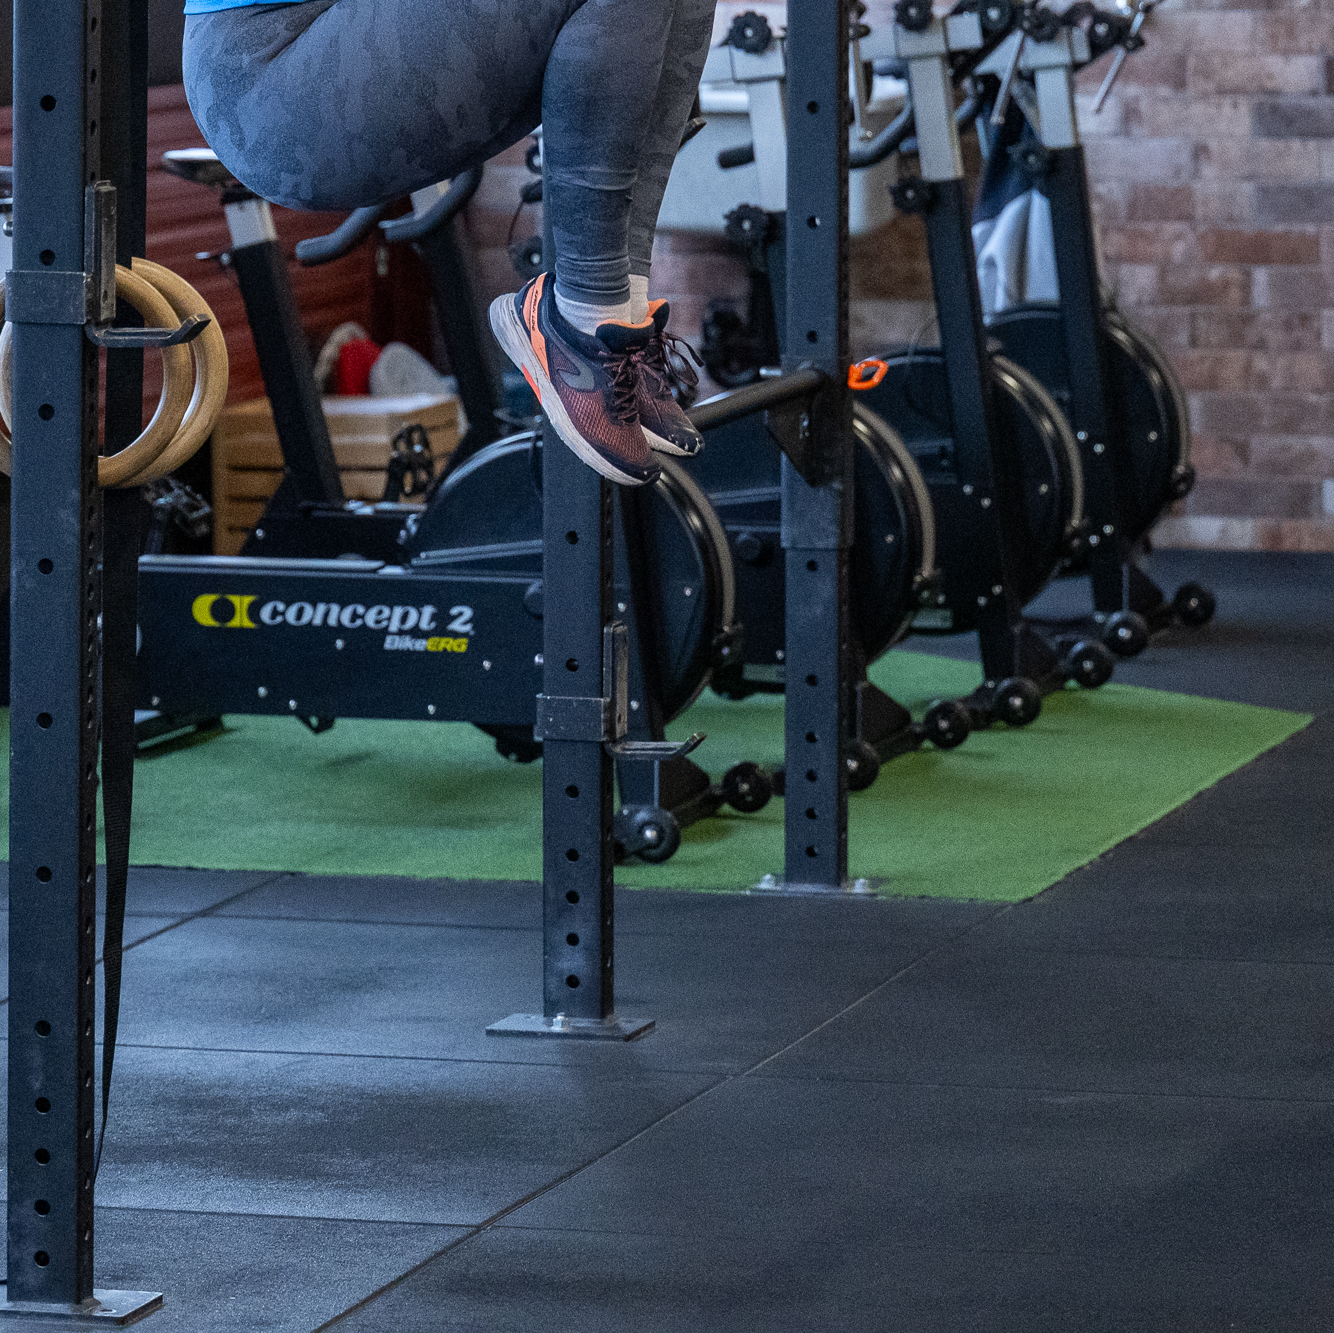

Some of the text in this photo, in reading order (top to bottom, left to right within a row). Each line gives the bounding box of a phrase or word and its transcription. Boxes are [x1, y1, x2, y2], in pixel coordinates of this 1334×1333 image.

[259, 600, 474, 633] concept 2
[383, 634, 468, 653] BikeERG
